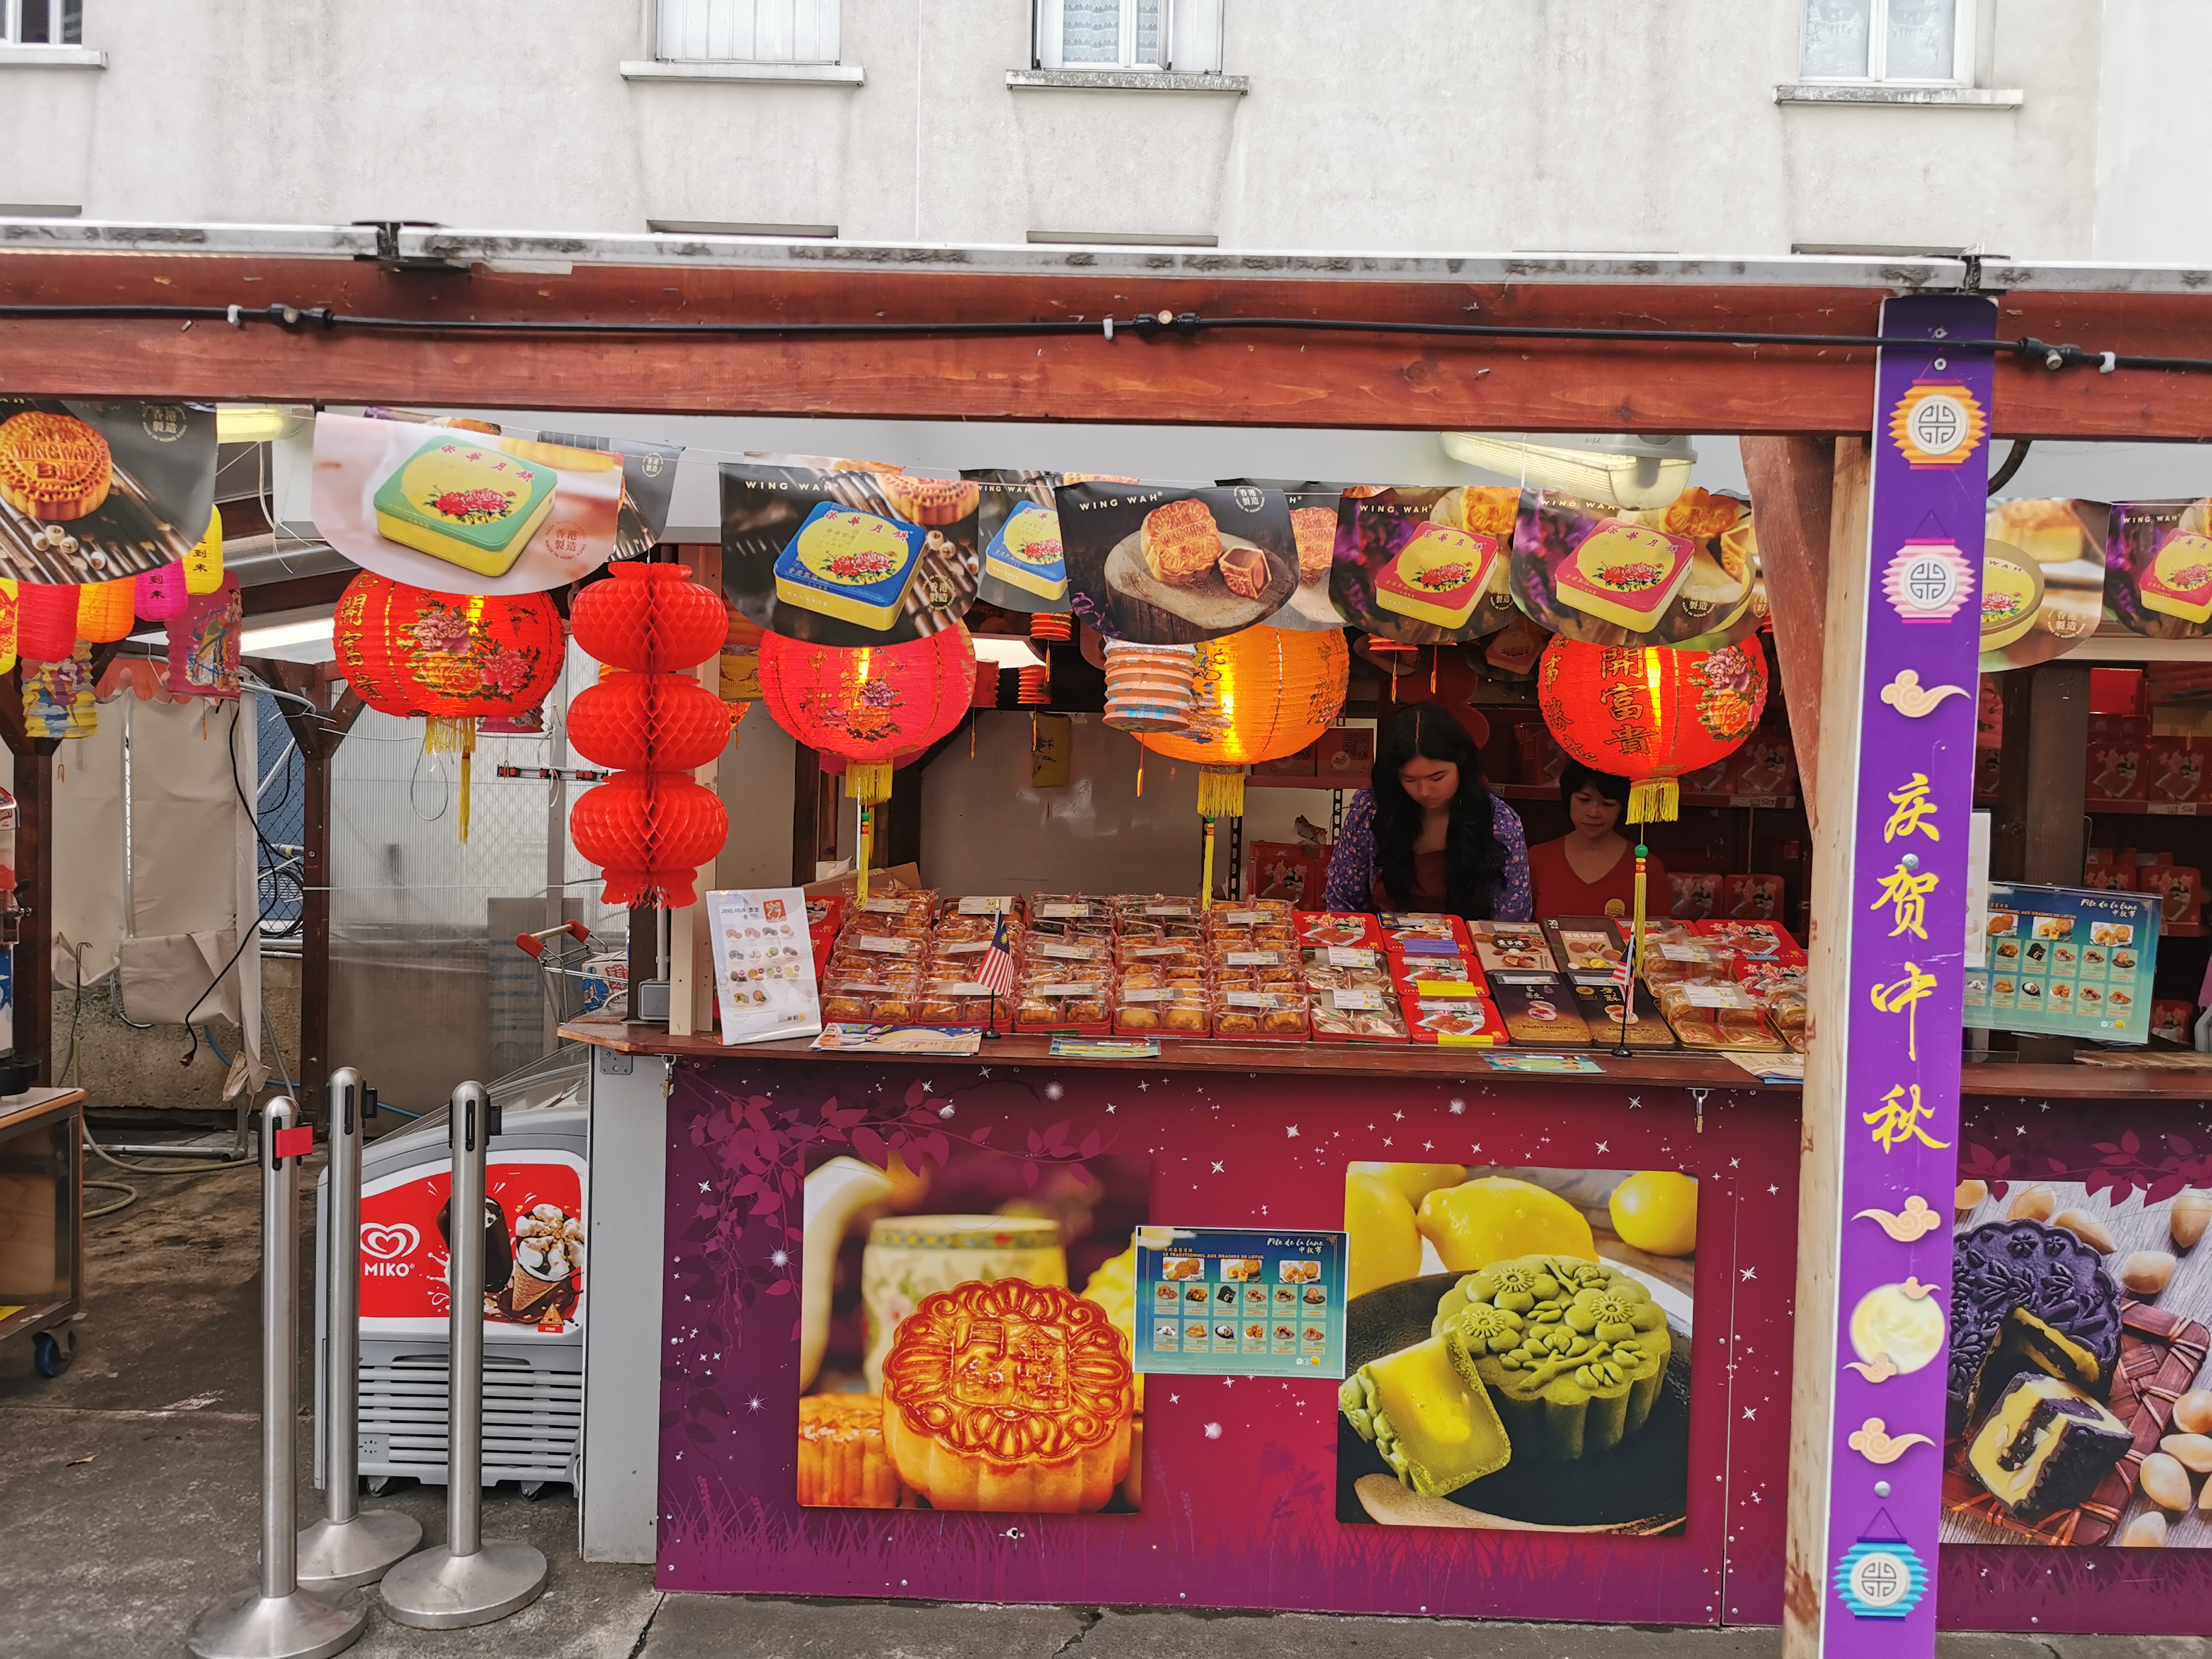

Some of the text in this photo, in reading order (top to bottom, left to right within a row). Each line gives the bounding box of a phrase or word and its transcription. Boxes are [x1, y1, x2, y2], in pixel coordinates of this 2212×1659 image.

[745, 481, 788, 490] WING
[1079, 494, 1158, 511] WING WAH
[1359, 504, 1395, 513] WING
[1989, 560, 2023, 572] WAH
[1862, 773, 1951, 1154] 庆贺中秋
[364, 1262, 409, 1277] MIKO
